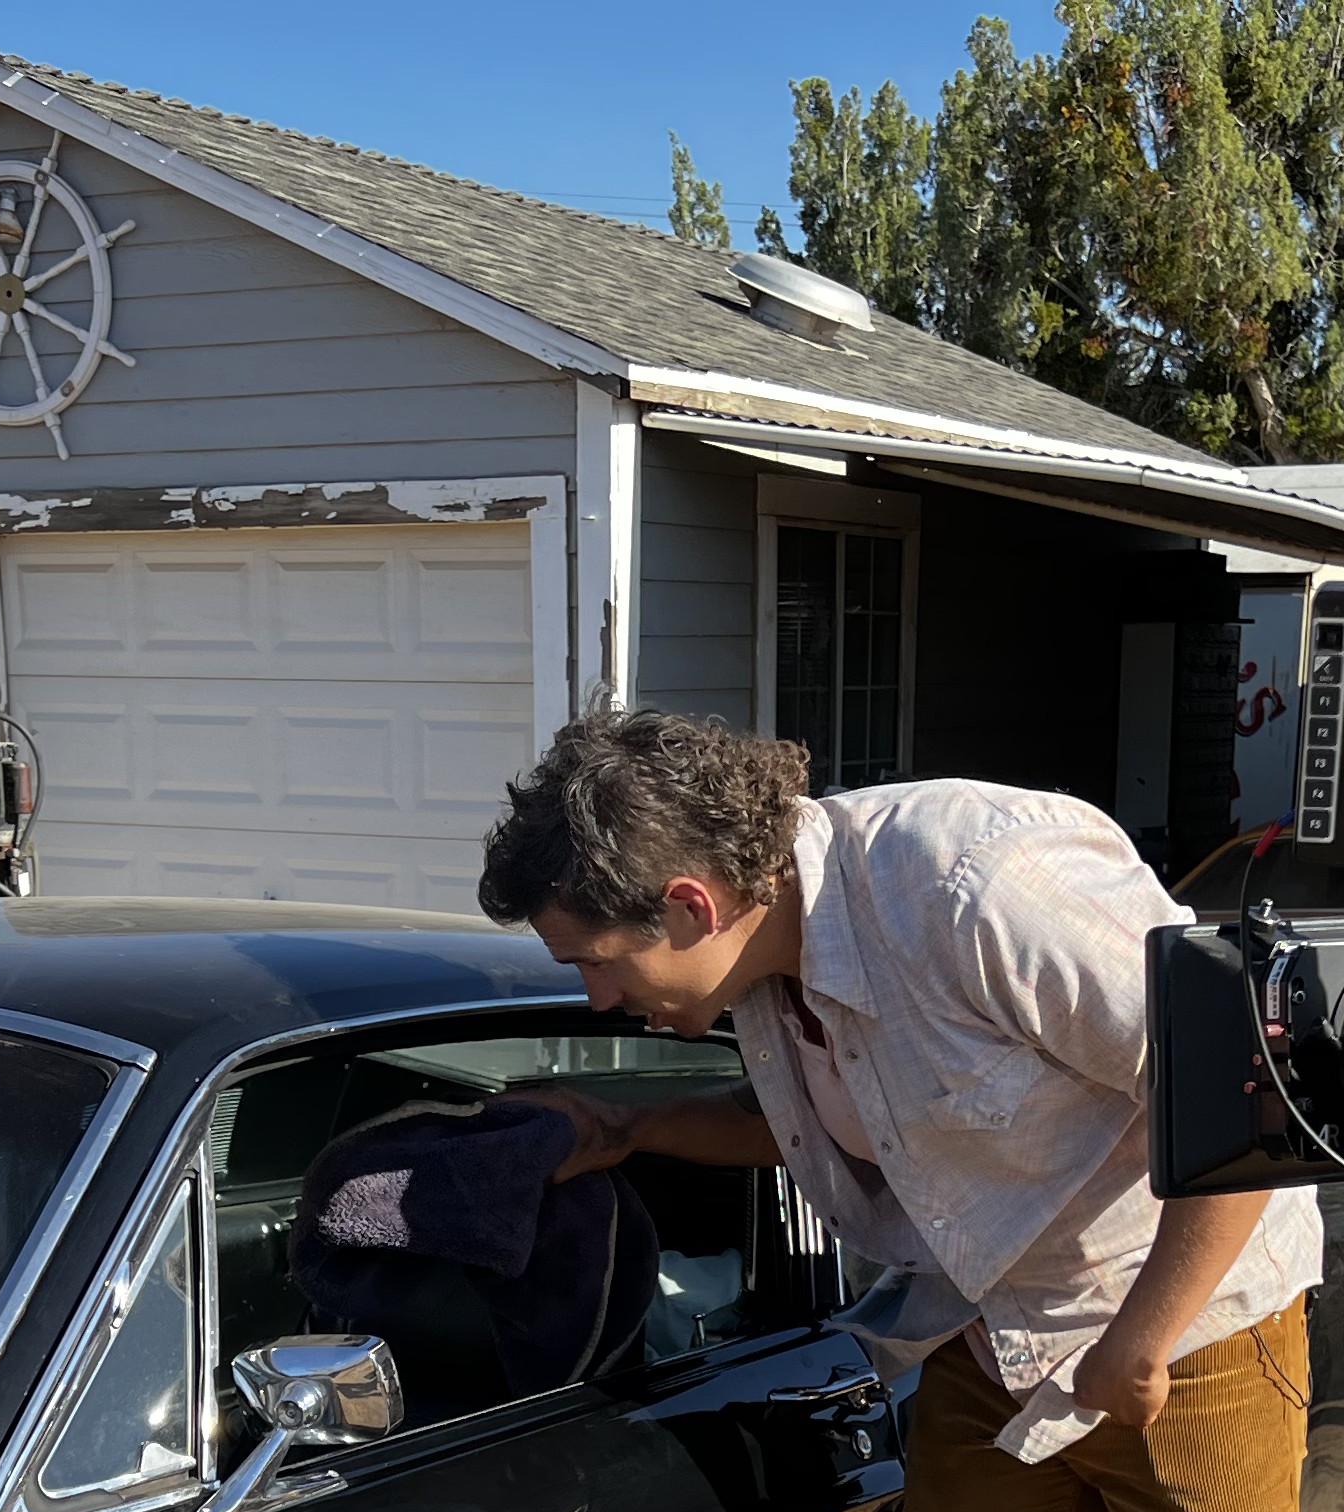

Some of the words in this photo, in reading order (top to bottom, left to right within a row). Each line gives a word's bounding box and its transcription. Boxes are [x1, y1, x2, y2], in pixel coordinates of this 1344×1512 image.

[1319, 695, 1330, 706] F1
[1317, 727, 1329, 738] F2
[1314, 758, 1327, 769] F3
[1311, 788, 1324, 799] F4
[1309, 819, 1322, 829] F5
